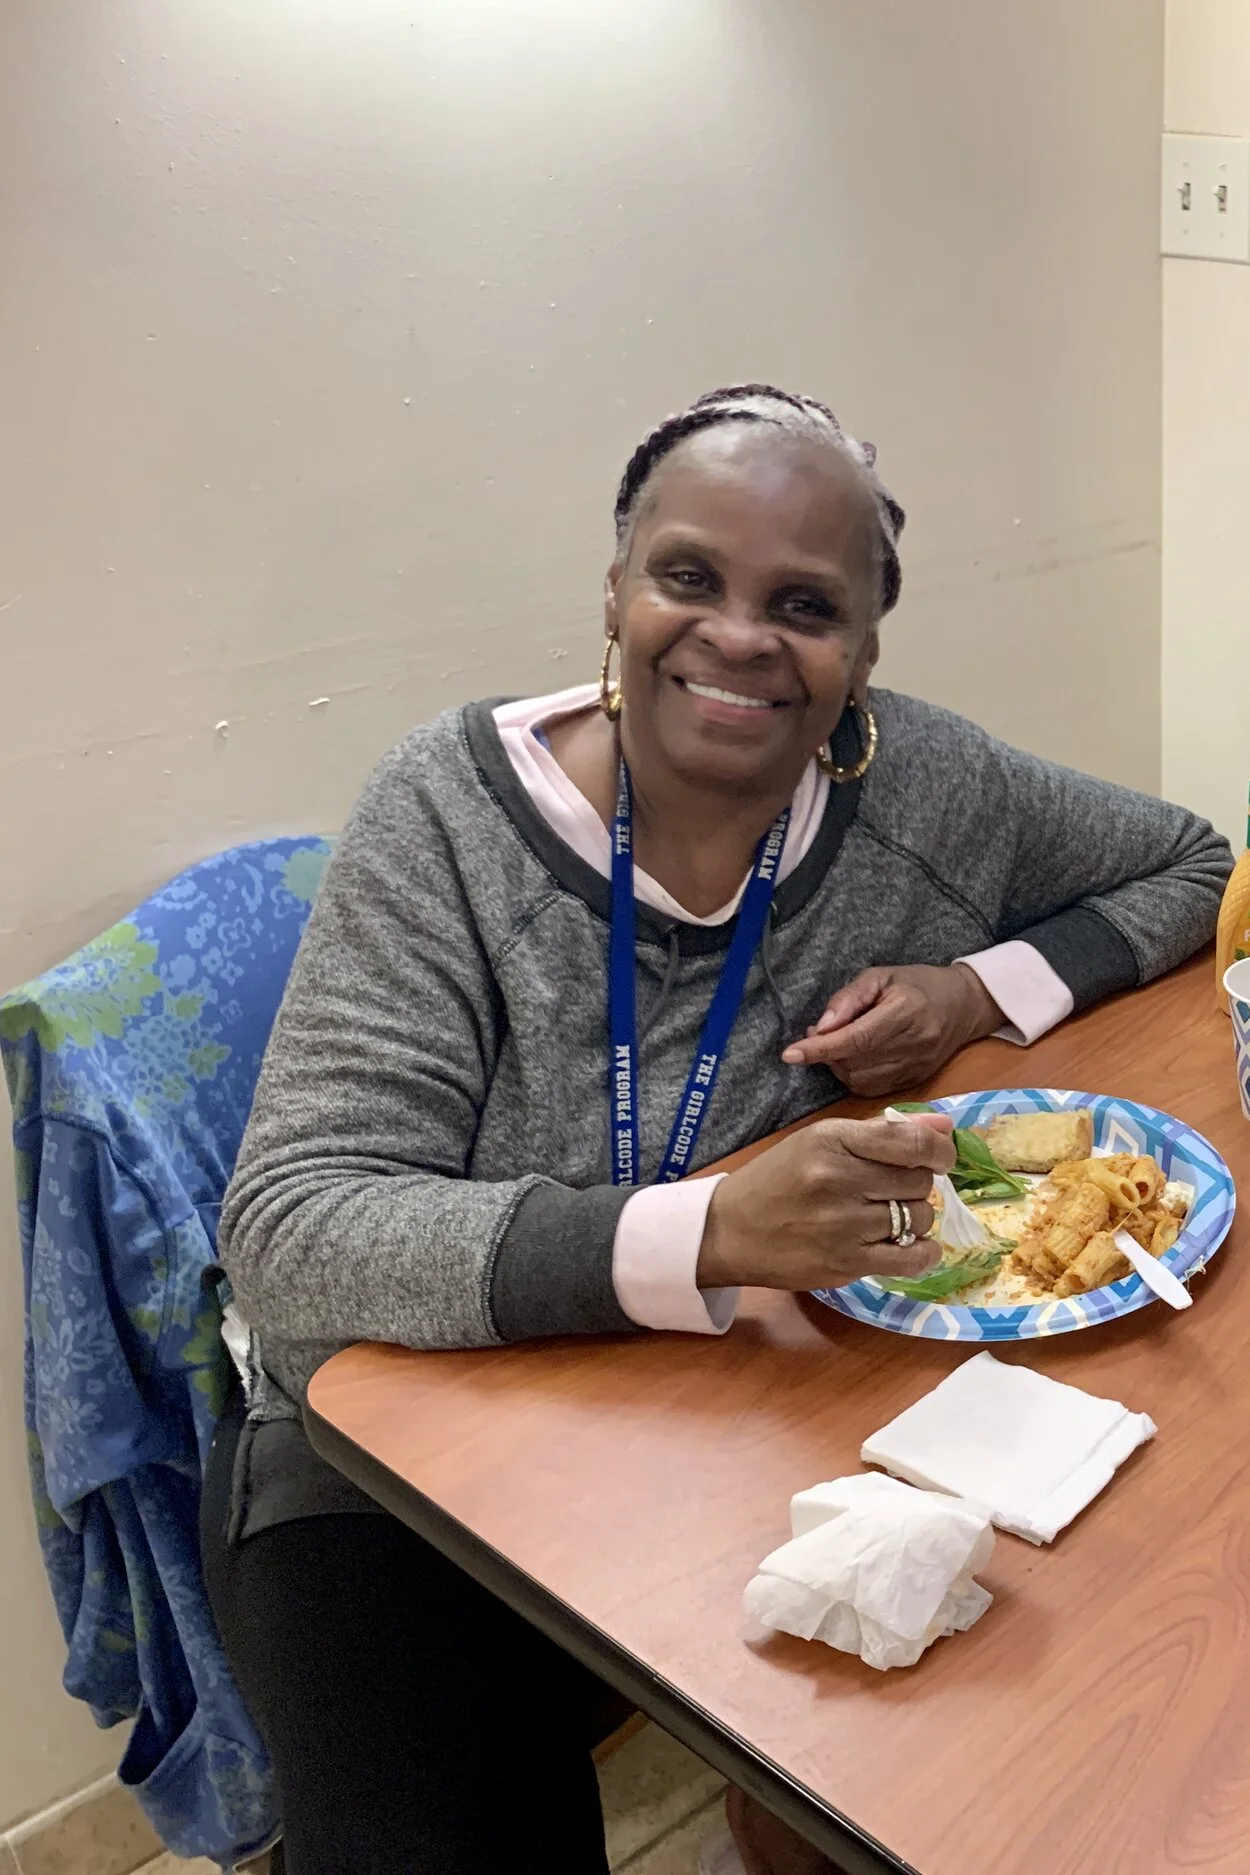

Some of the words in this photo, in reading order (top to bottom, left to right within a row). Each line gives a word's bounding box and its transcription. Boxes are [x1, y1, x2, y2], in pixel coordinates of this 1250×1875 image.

[616, 823, 630, 855] THE
[615, 1044, 632, 1122] PROGRAM
[695, 1053, 718, 1086] THE
[671, 1090, 706, 1166] GIRLCODE
